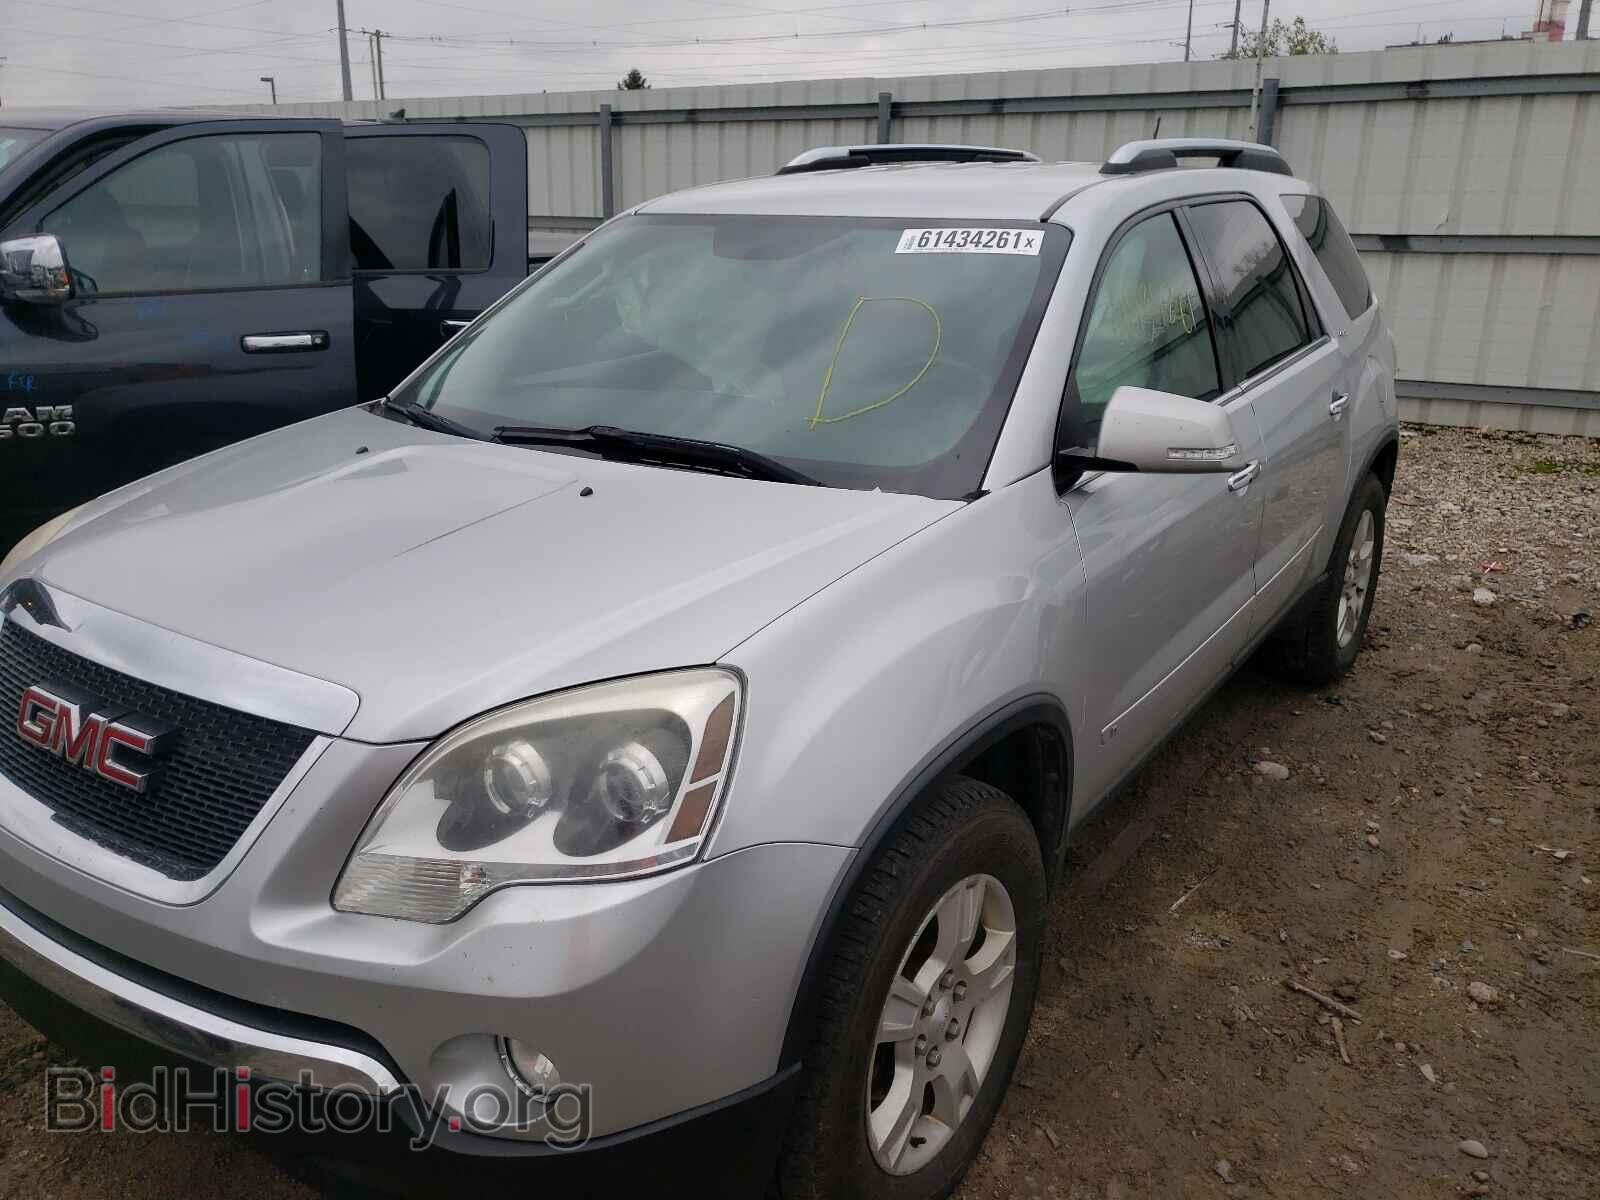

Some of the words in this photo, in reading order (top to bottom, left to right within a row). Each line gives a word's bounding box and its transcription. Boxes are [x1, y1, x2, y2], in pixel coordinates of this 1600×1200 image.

[917, 230, 1022, 249] 61434261
[803, 296, 942, 432] D
[16, 685, 157, 794] GMC
